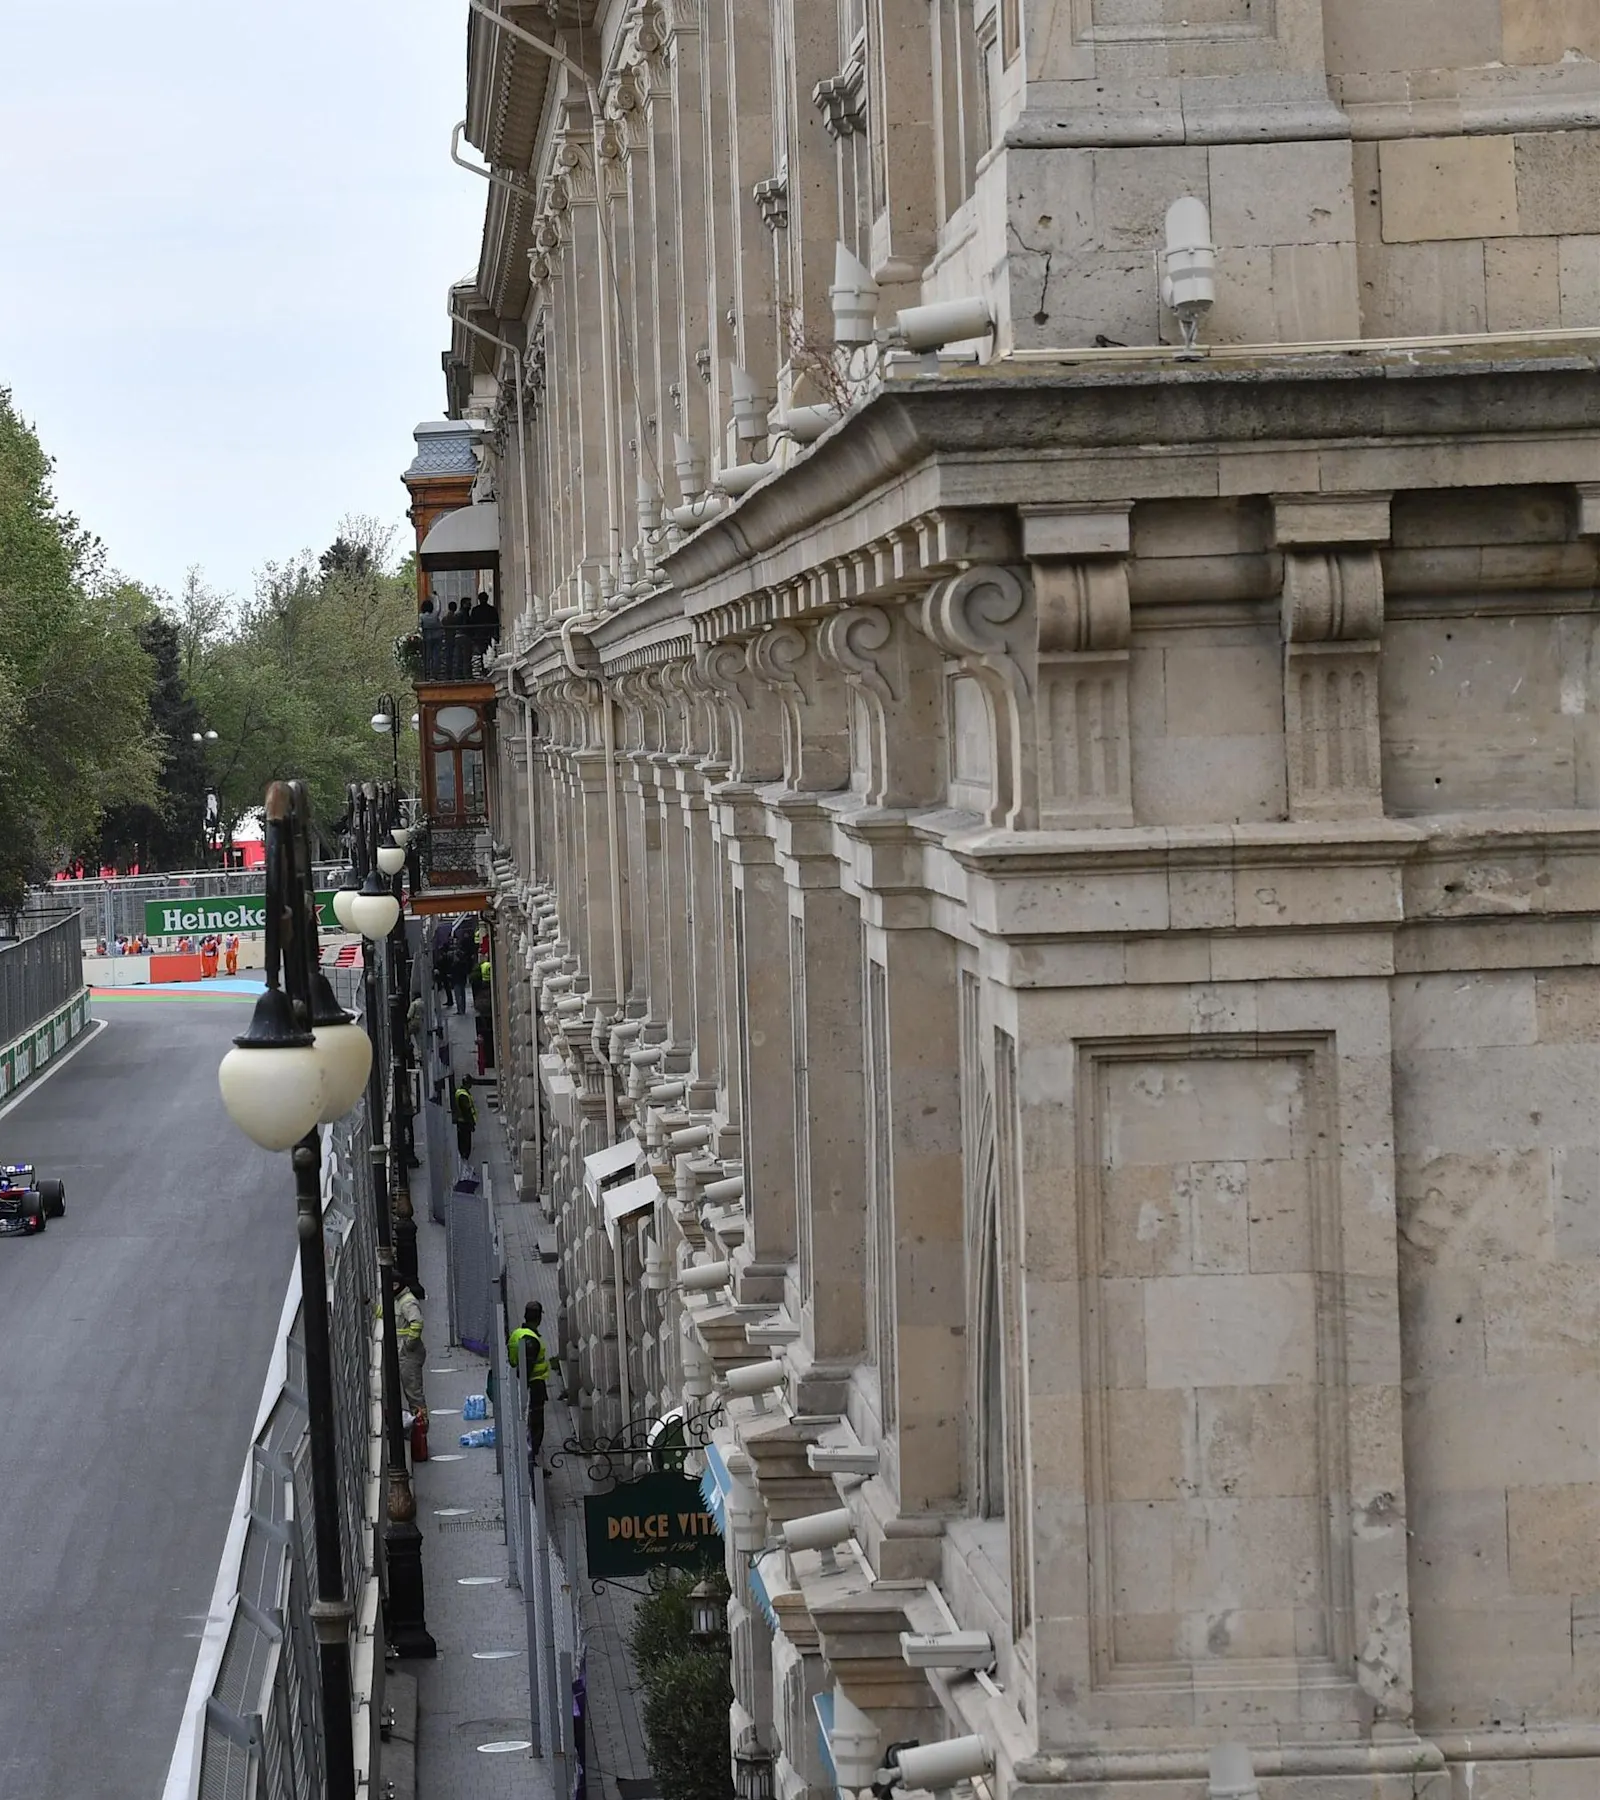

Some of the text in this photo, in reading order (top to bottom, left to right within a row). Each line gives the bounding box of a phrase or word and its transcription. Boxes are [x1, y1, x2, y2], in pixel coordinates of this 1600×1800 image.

[162, 905, 266, 931] Heineke
[607, 1514, 669, 1539] DOLCE
[633, 1538, 667, 1553] Since
